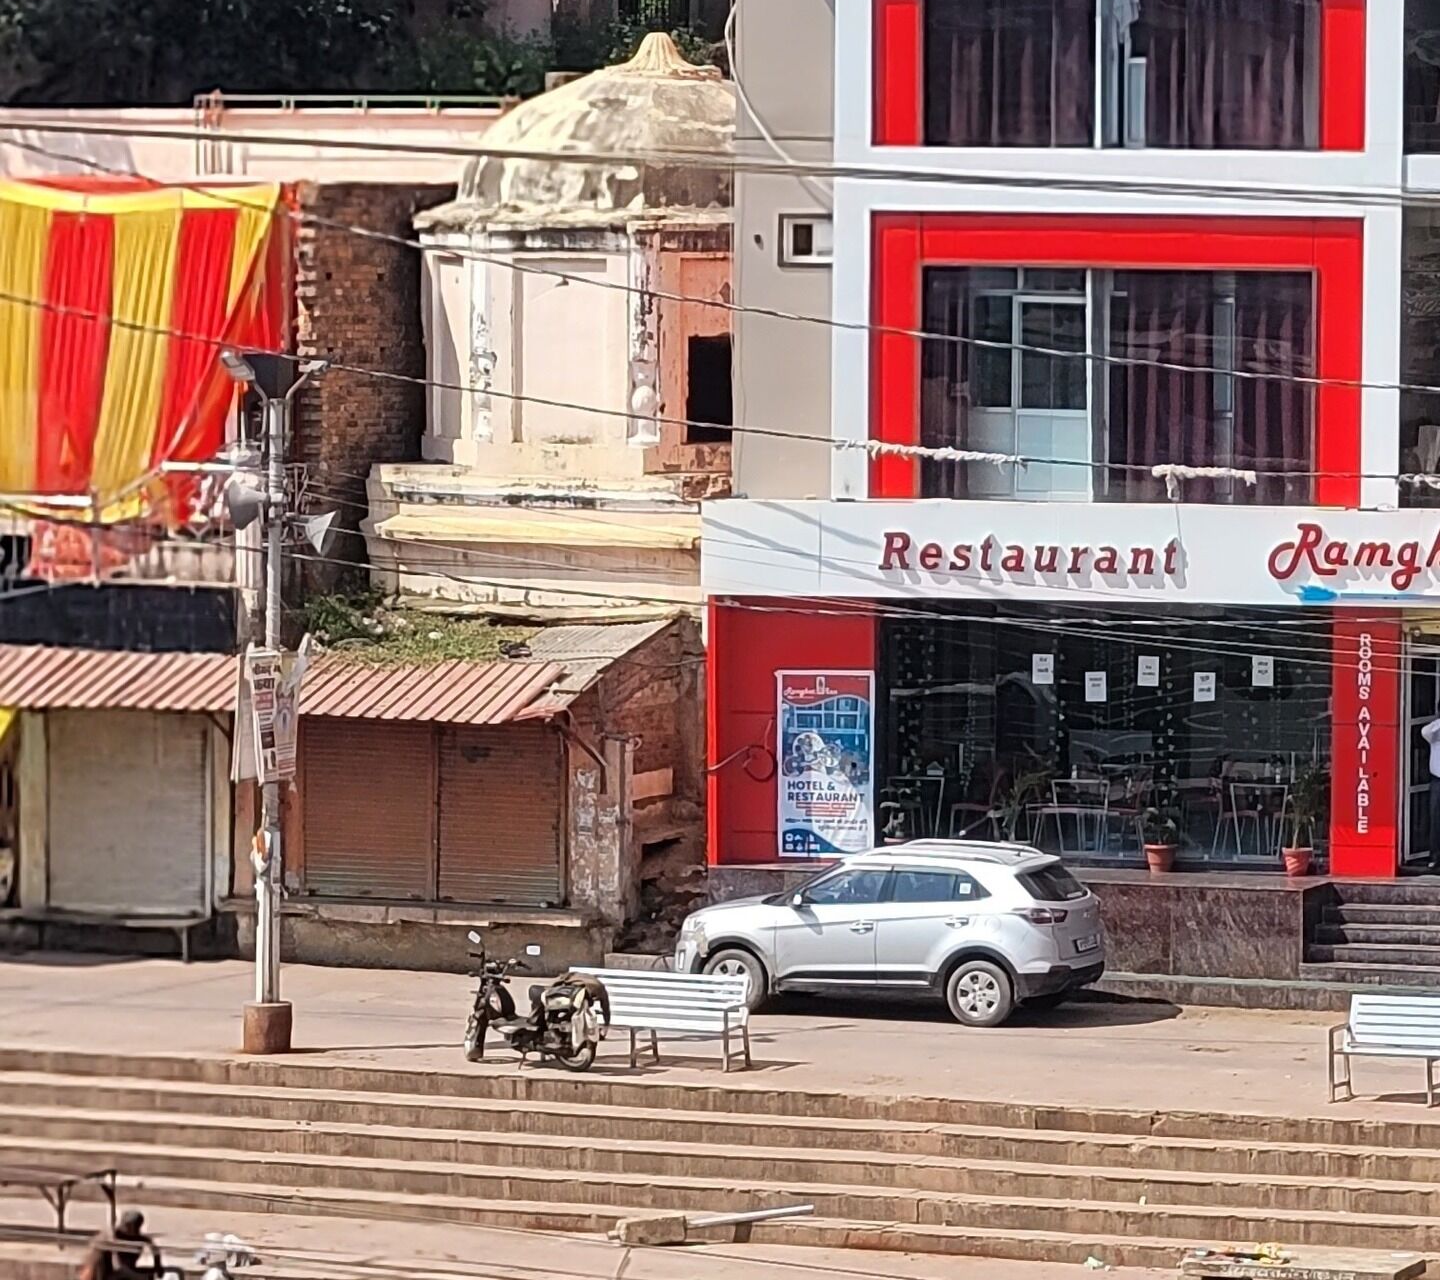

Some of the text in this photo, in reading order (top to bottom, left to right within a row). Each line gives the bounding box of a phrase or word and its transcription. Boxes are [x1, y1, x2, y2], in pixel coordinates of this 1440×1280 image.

[878, 532, 1177, 575] Restaurant
[1357, 633, 1373, 834] ROOMS AVAILABLE
[787, 781, 836, 791] HOTEL &
[787, 792, 865, 802] RESTAURANT
